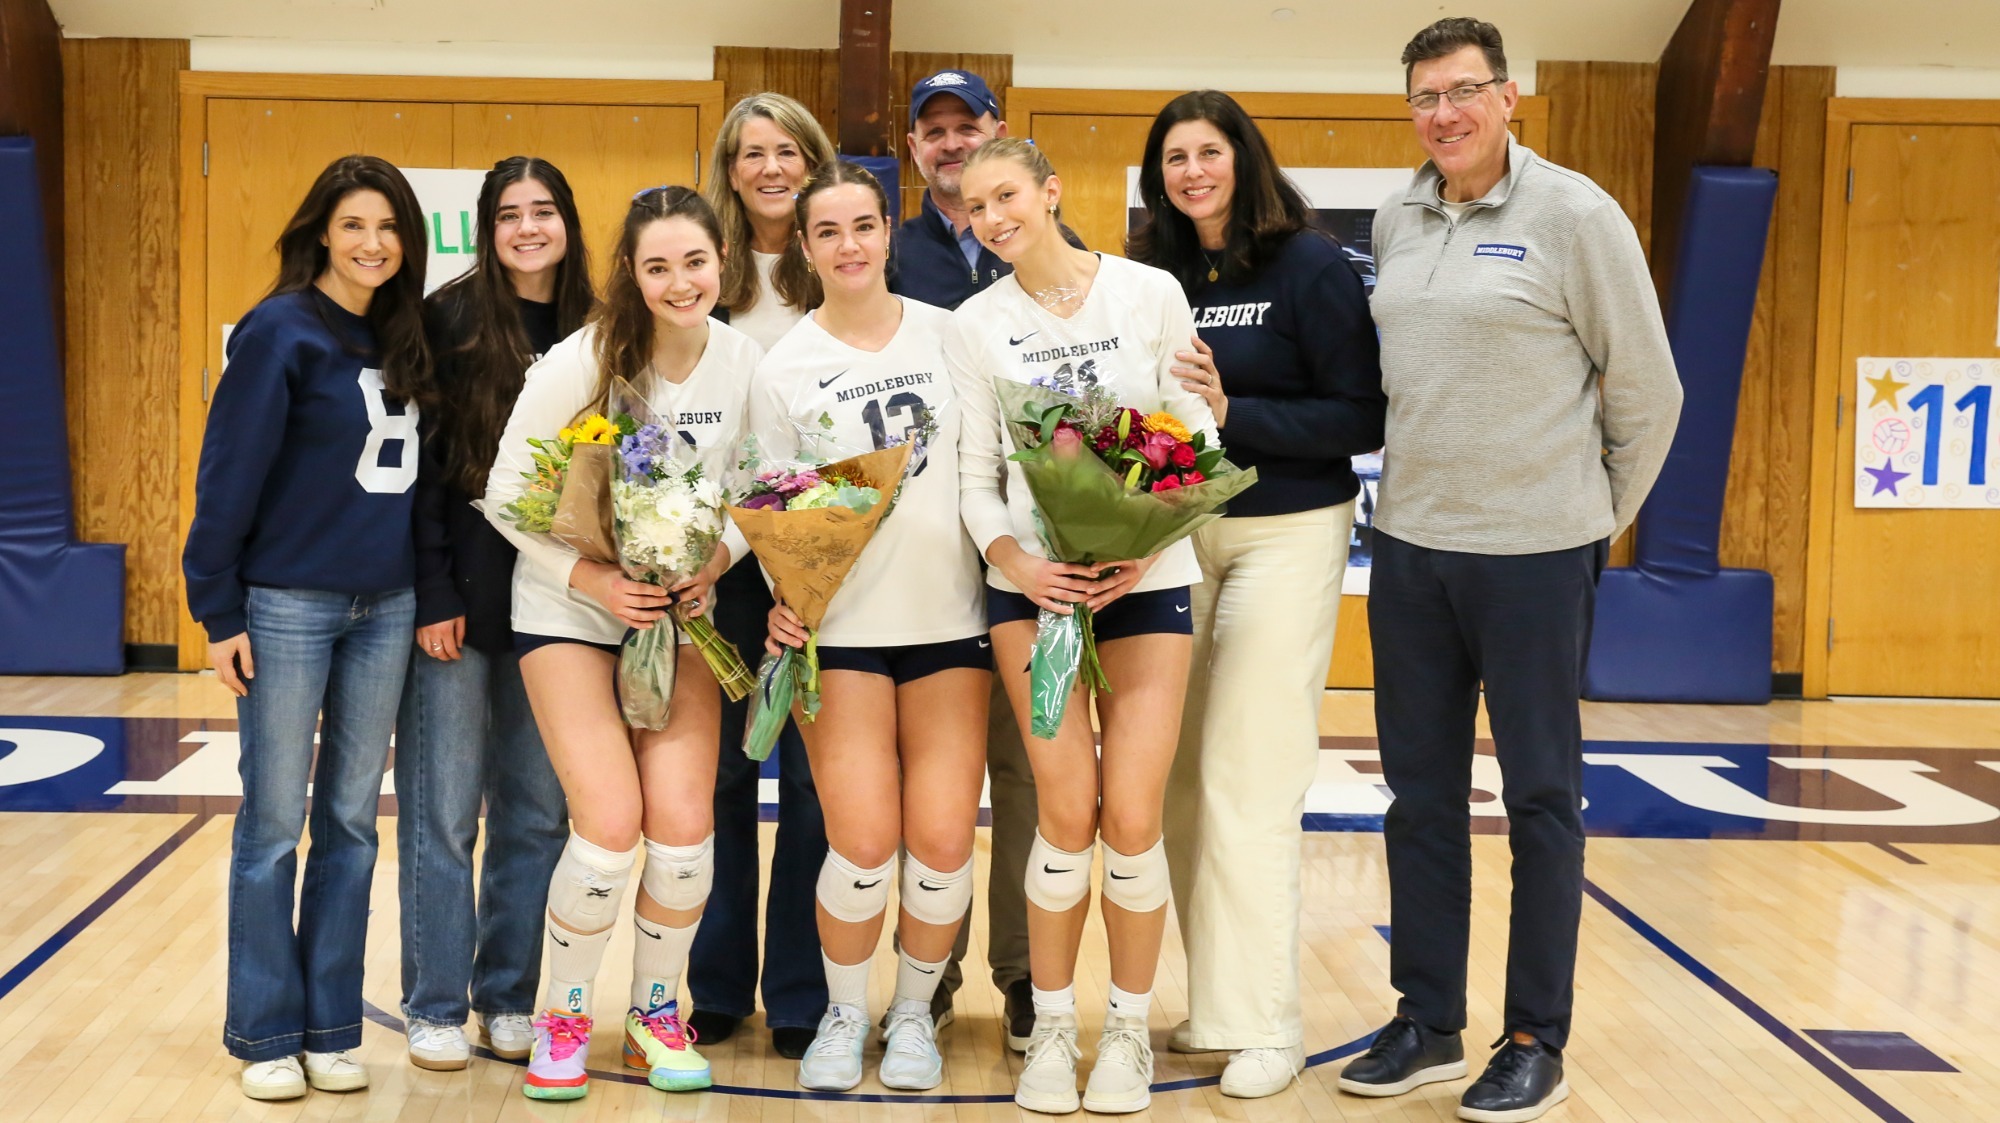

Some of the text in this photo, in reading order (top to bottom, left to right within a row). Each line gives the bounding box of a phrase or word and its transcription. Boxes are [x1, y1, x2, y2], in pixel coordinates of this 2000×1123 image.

[423, 210, 480, 254] LL
[1022, 336, 1119, 364] MIDDLEBURY
[836, 372, 933, 403] MIDDLEBURY
[355, 367, 420, 494] 8
[1907, 384, 1992, 486] 11
